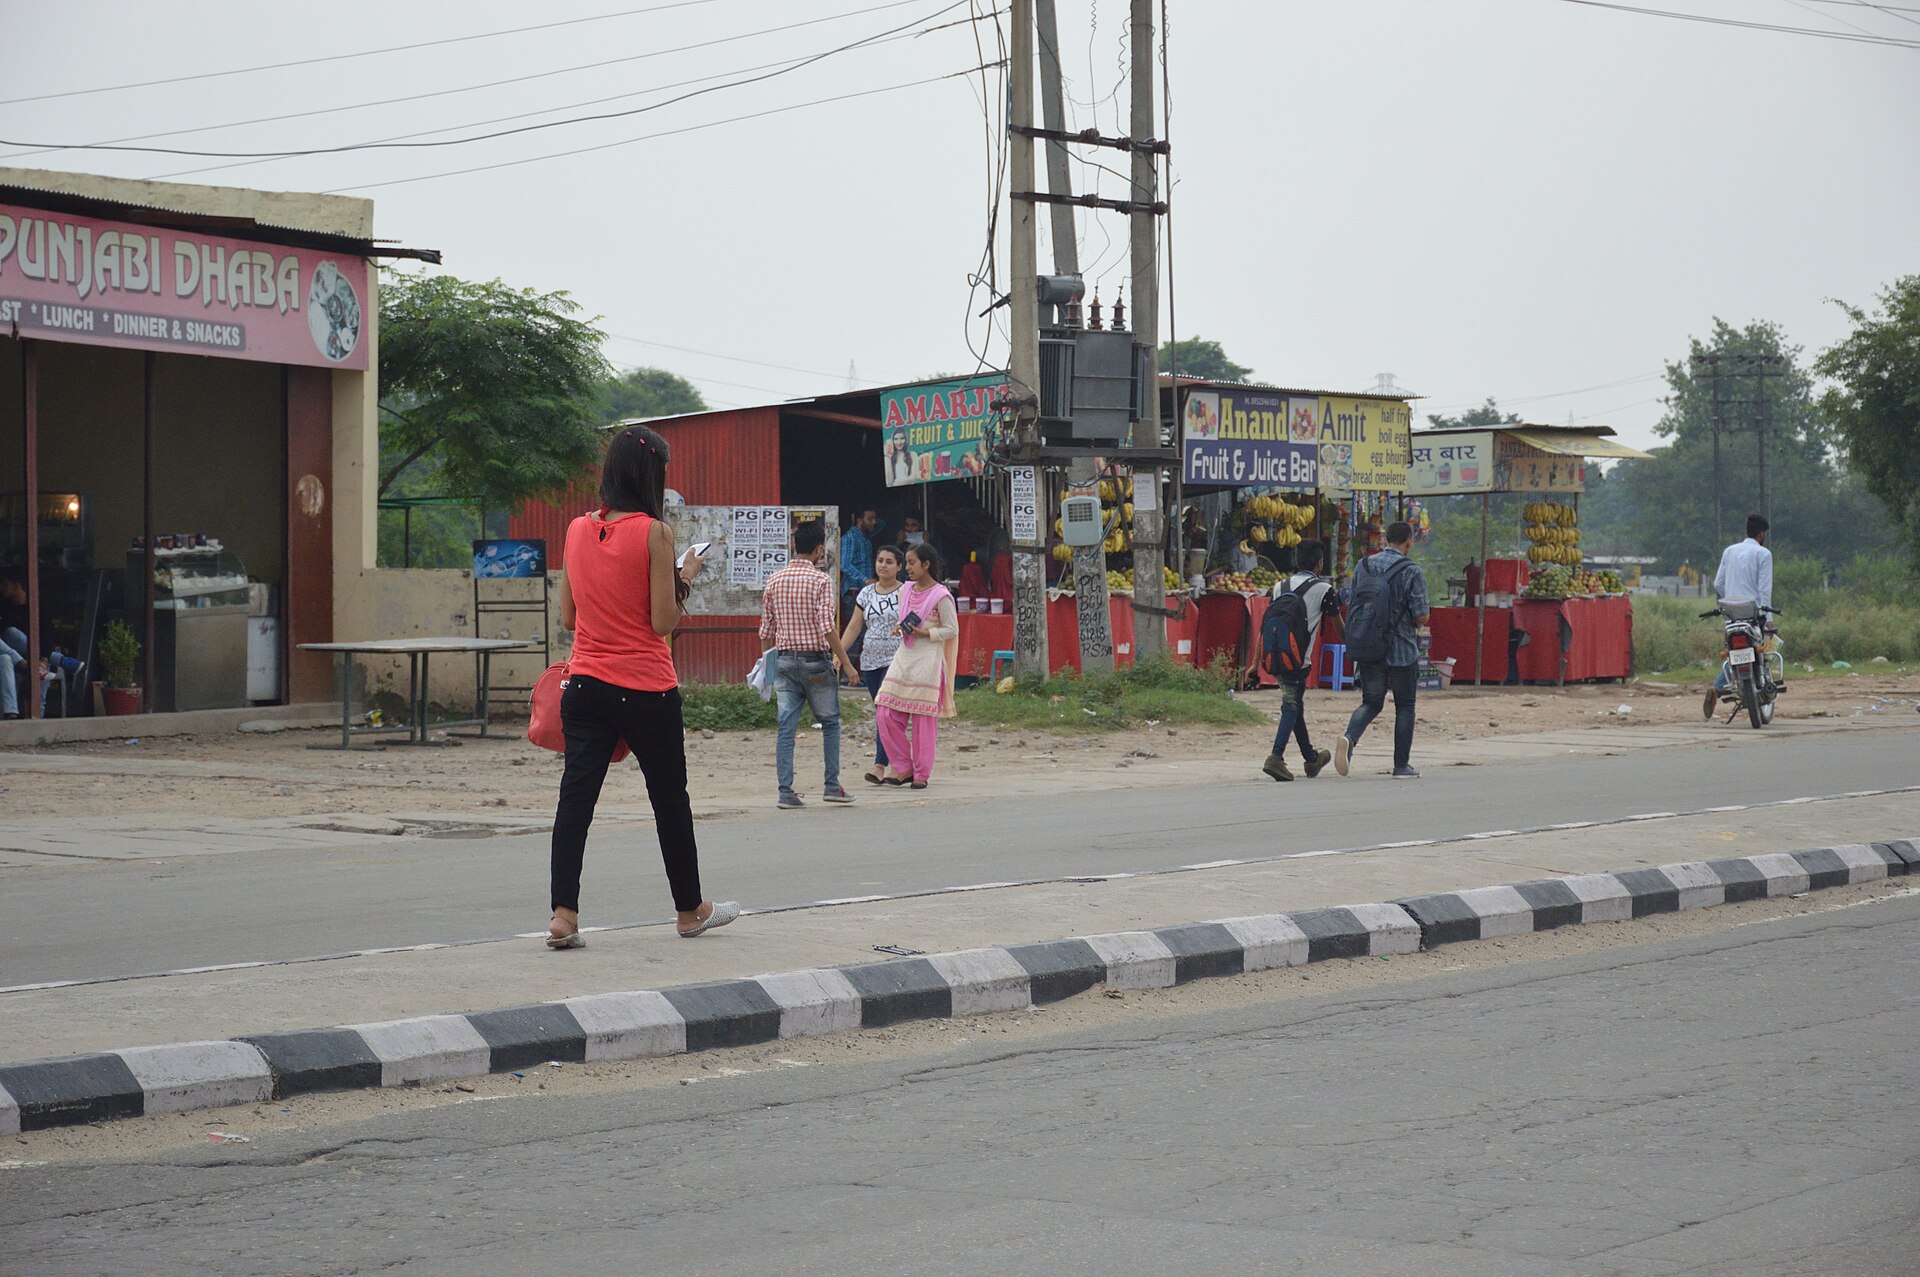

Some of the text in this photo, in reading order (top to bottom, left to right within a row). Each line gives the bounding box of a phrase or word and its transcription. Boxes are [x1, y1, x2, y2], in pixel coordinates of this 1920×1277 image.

[173, 241, 300, 314] DHABA
[0, 300, 241, 346] ST LUNCH DINNER & SNACKS
[1219, 398, 1288, 441] Anand
[1320, 401, 1366, 442] Amit
[1381, 407, 1408, 426] half fry
[909, 424, 942, 447] FRUIT
[947, 423, 955, 440] &
[960, 418, 989, 440] JUIC
[1395, 432, 1407, 447] egg
[1371, 451, 1383, 467] egg
[1440, 446, 1477, 460] बार
[1191, 447, 1316, 482] Fruit & Juice Bar
[1013, 470, 1033, 479] PG
[1353, 469, 1406, 485] bread omelette
[735, 511, 758, 520] PG
[763, 511, 785, 520] PG
[1014, 505, 1034, 515] PG
[734, 550, 757, 559] PG
[763, 553, 786, 562] PG
[1018, 605, 1037, 621] BOY
